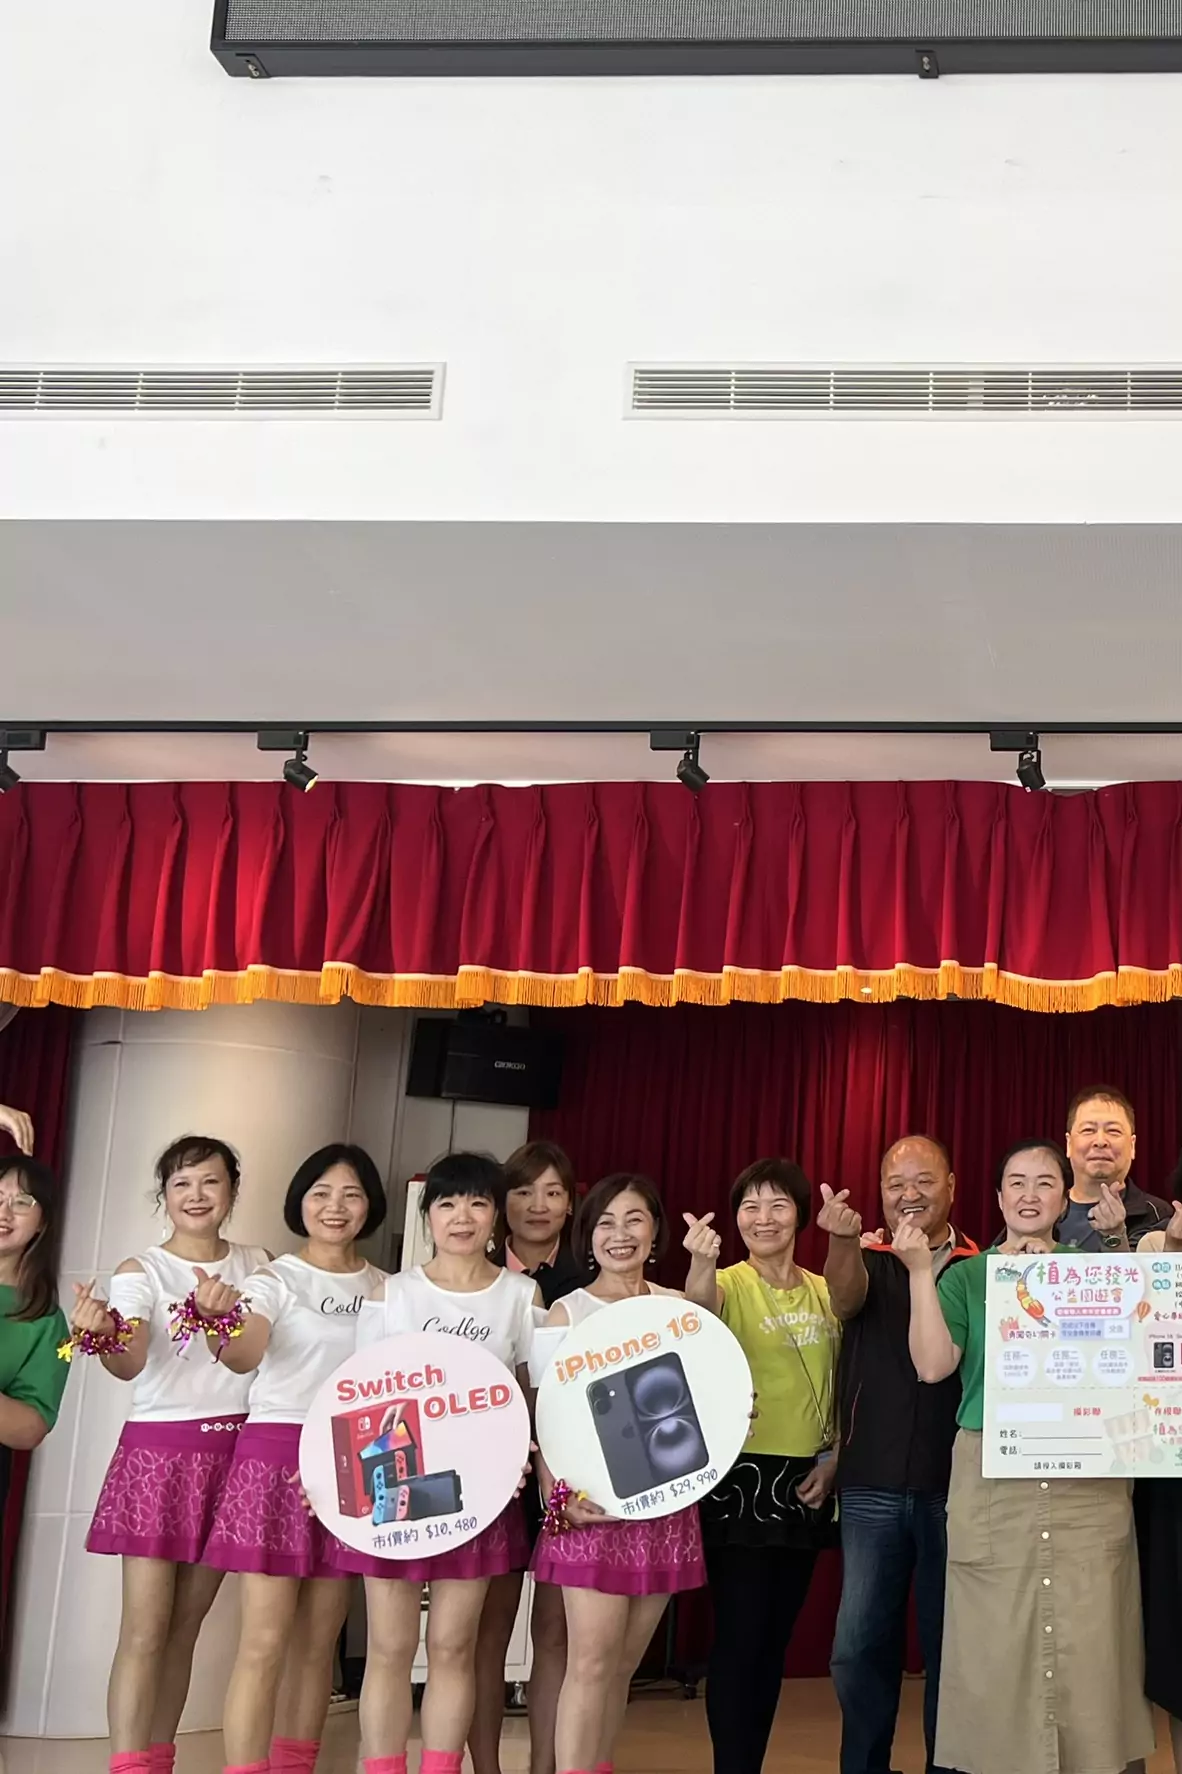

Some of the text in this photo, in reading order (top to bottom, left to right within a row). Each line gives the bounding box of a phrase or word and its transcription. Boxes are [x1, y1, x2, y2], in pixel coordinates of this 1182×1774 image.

[1037, 1261, 1139, 1285] 植為您發光
[555, 1312, 700, 1383] iPhone 16
[336, 1364, 444, 1402] Switch
[423, 1384, 511, 1419] OLED
[622, 1469, 718, 1515] 市價約 $29,990
[372, 1516, 478, 1549] 市價約 $10,480
